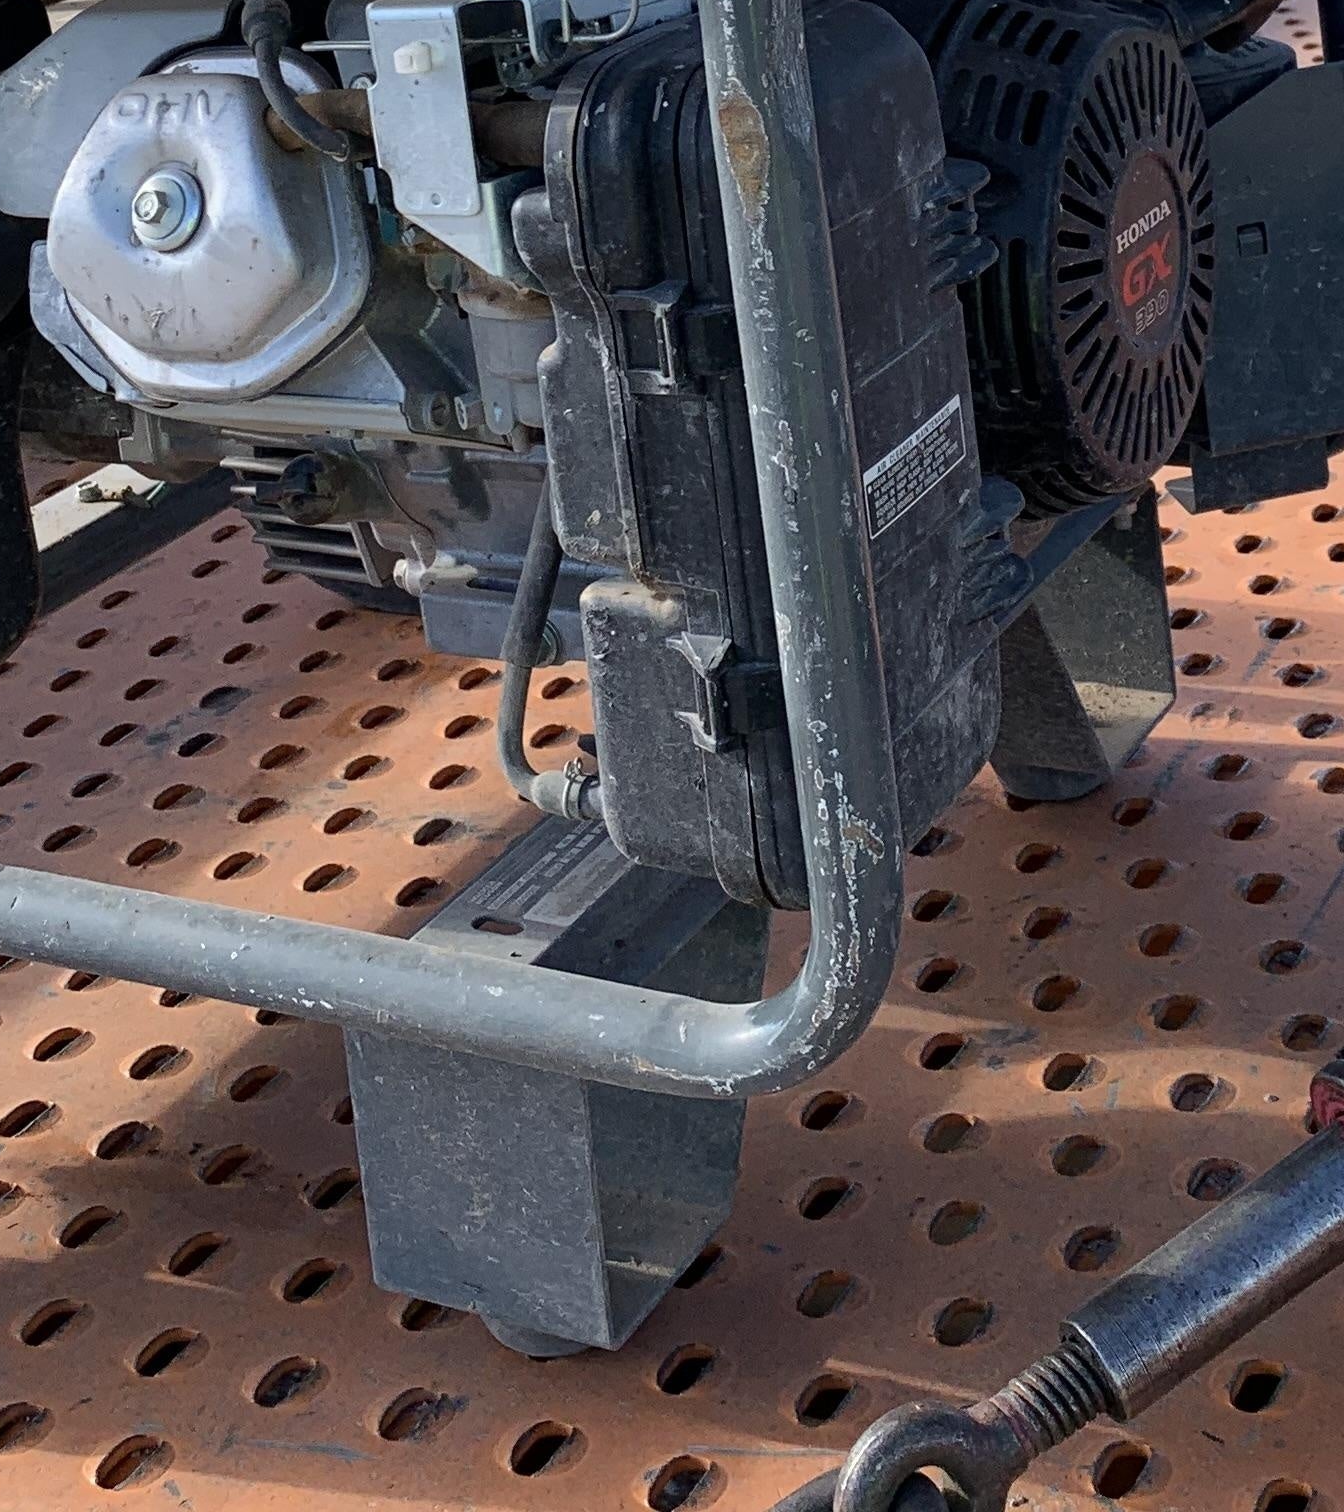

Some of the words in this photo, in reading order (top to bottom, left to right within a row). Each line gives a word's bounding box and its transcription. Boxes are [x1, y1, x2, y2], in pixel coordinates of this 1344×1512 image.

[1116, 200, 1172, 254] HONDA
[1123, 232, 1172, 306] GX
[1135, 289, 1169, 335] 390
[876, 461, 887, 473] AIR
[889, 438, 913, 464] CLEANER
